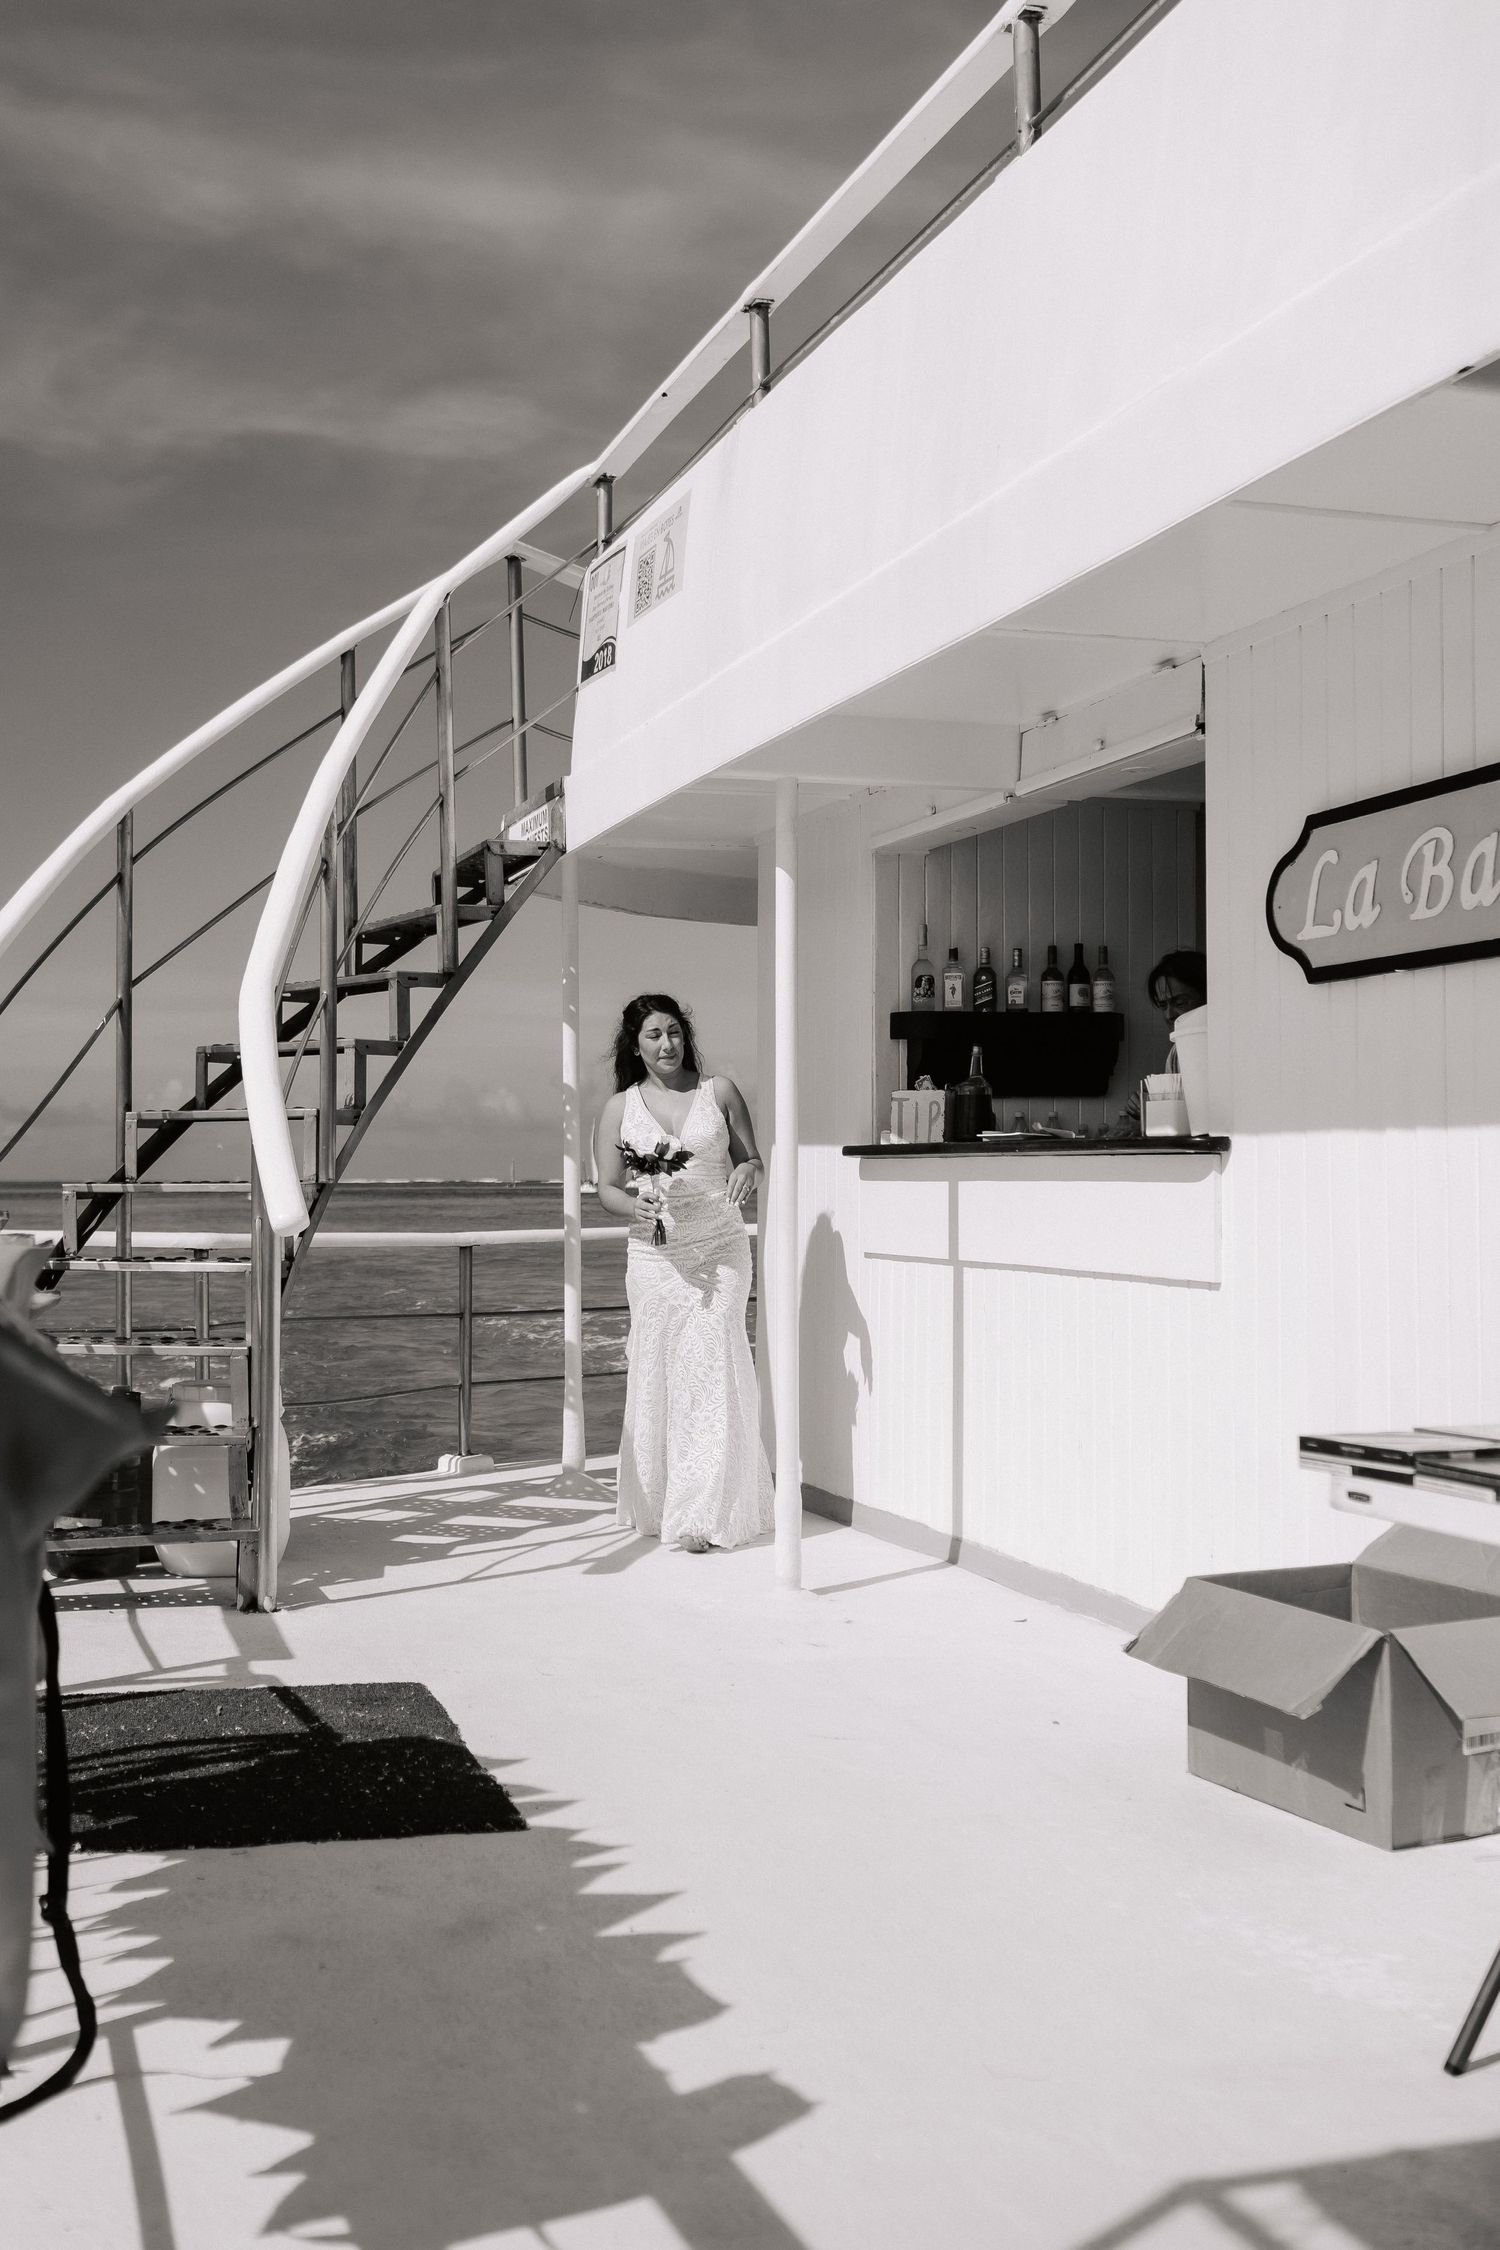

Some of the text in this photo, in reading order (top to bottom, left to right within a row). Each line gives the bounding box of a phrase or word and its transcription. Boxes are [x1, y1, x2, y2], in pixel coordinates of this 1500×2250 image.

[593, 646, 613, 674] 2018
[521, 809, 549, 836] MAXIMUM
[1296, 826, 1500, 941] La Ba
[891, 1096, 942, 1143] TIP
